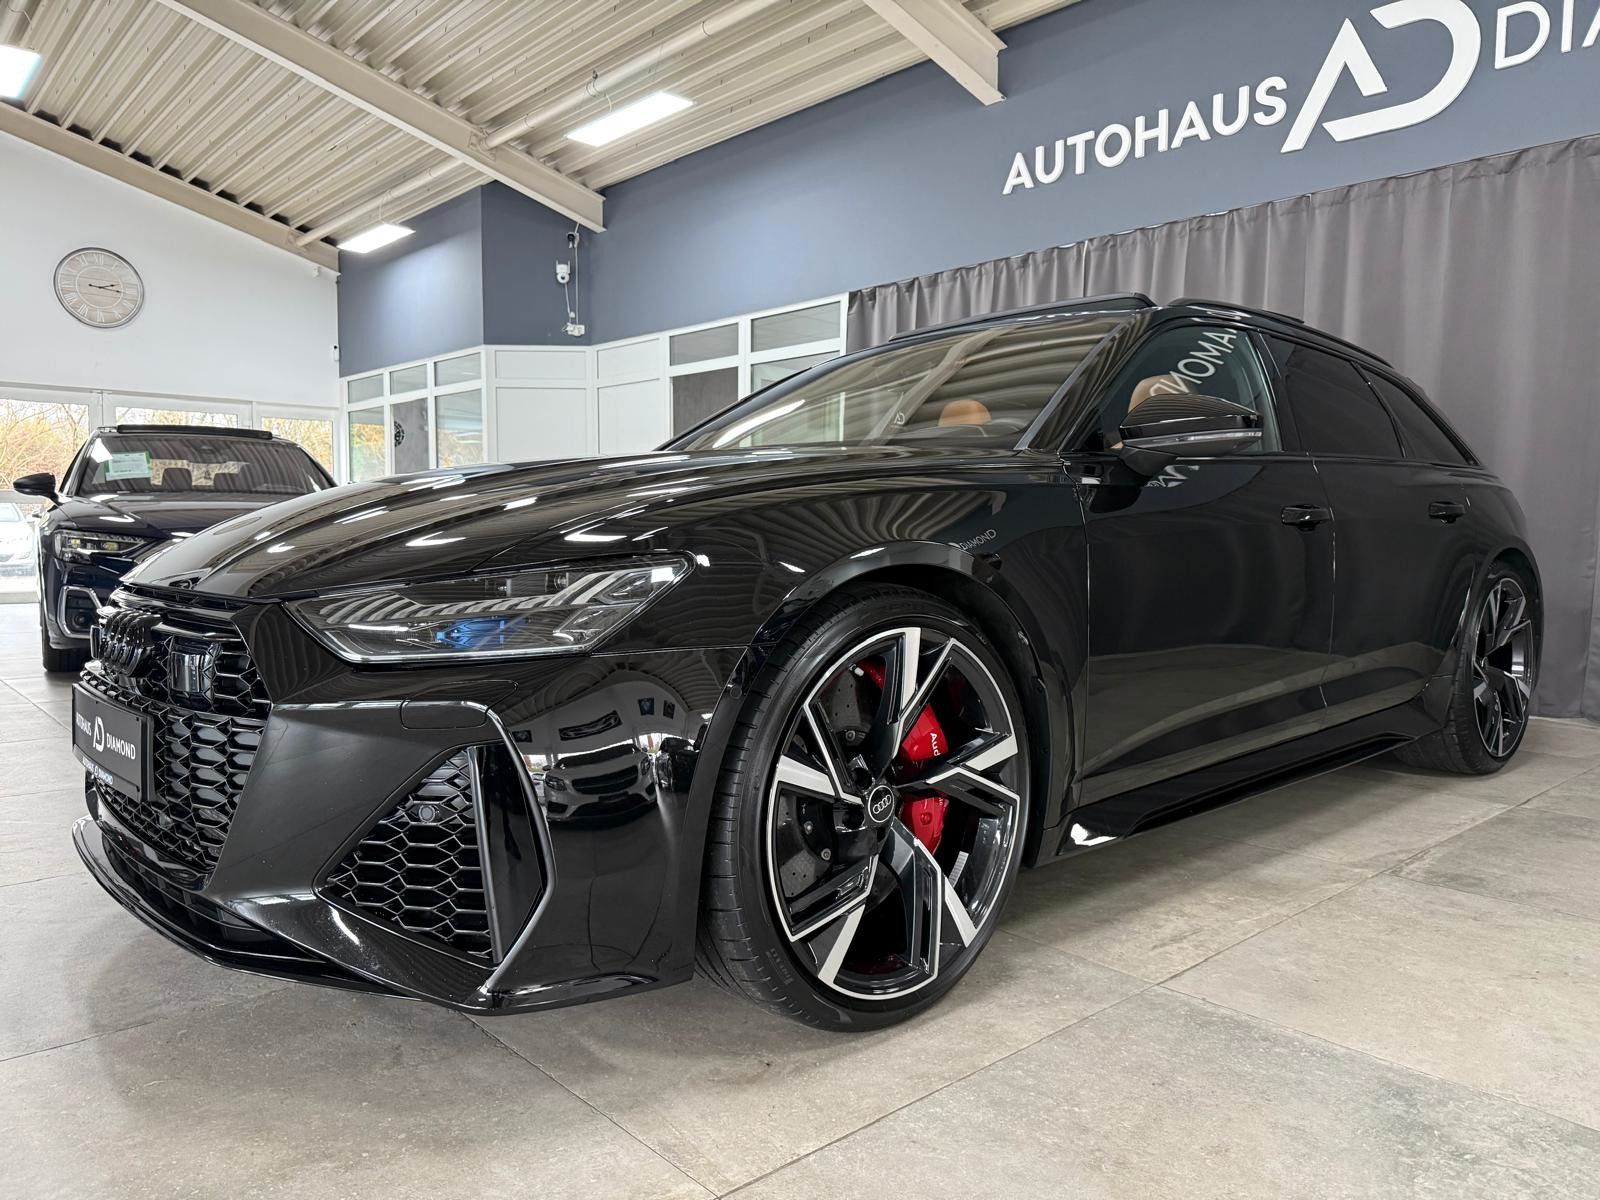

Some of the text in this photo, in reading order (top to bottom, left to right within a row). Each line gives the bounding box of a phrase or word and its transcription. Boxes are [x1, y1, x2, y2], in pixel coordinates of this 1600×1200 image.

[1002, 75, 1288, 195] AUTOHAUS
[1281, 0, 1482, 153] AD
[106, 733, 136, 760] DIAMOND
[930, 733, 941, 757] Aud
